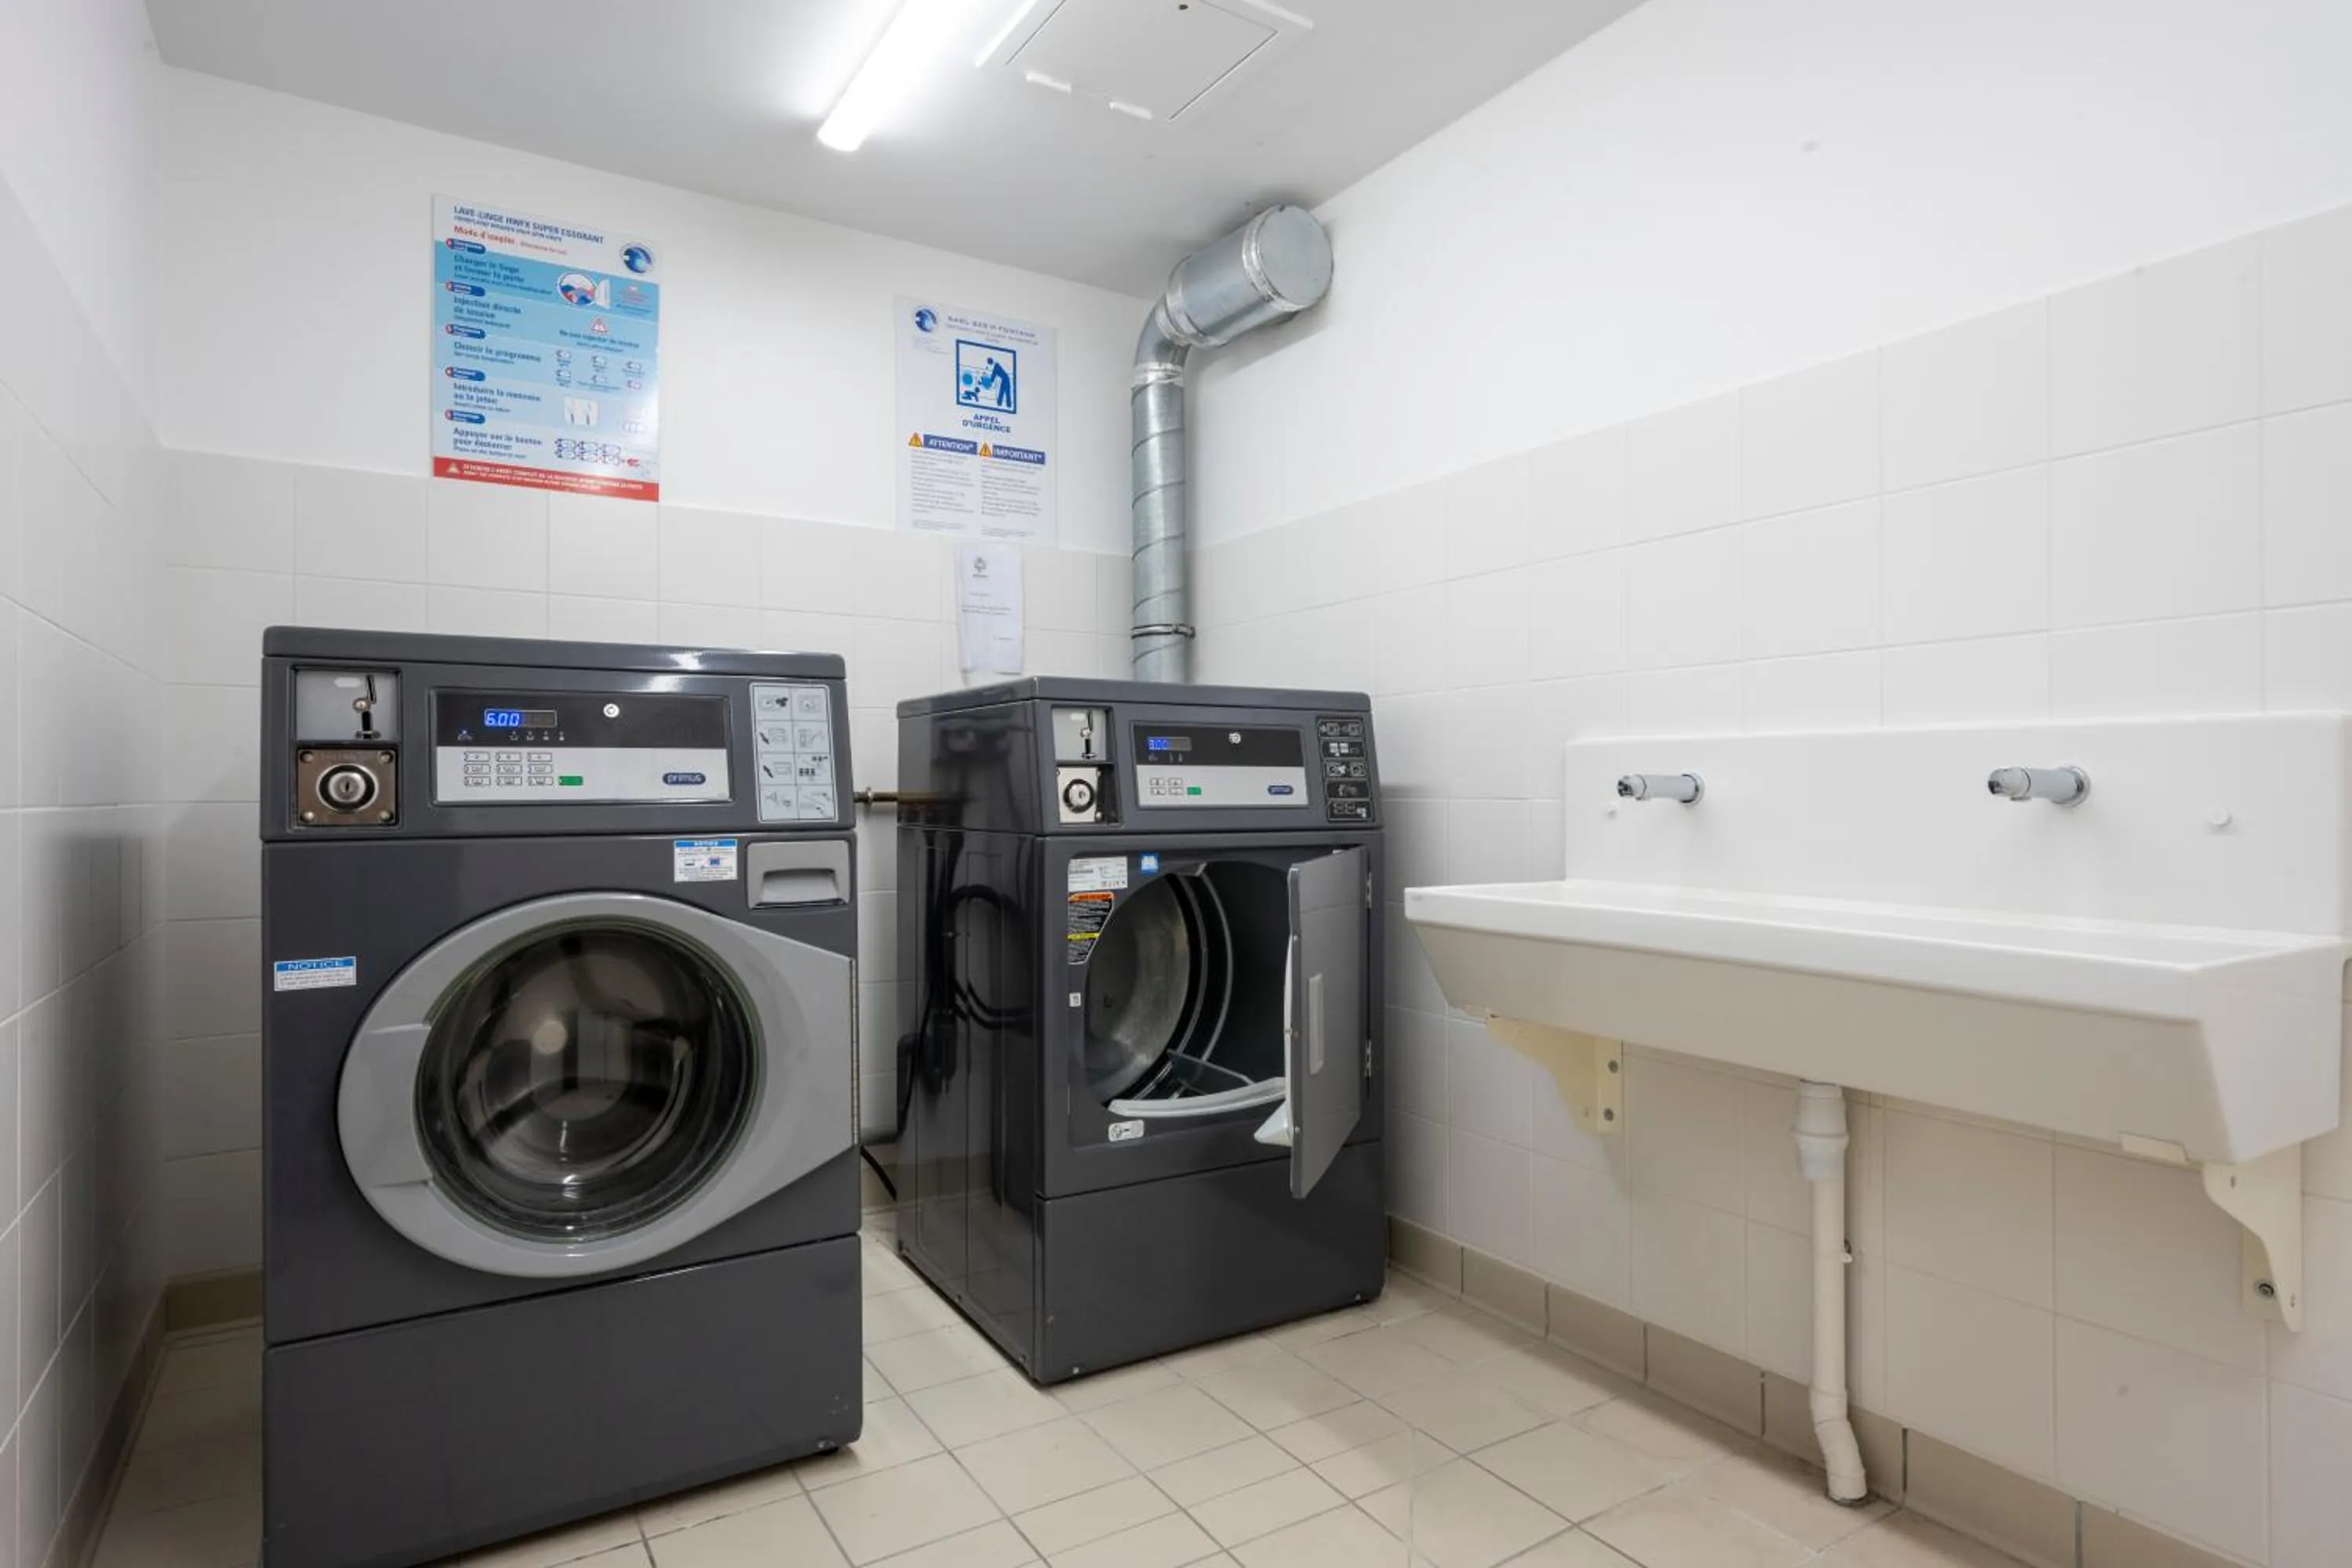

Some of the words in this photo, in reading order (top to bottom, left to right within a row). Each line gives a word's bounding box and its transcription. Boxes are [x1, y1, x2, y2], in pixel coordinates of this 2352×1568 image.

[532, 222, 559, 234] SUPER
[973, 412, 1001, 424] APPEL
[962, 419, 1011, 434] D'URGENCE
[667, 774, 702, 784] primus
[288, 960, 345, 971] NOTICE
